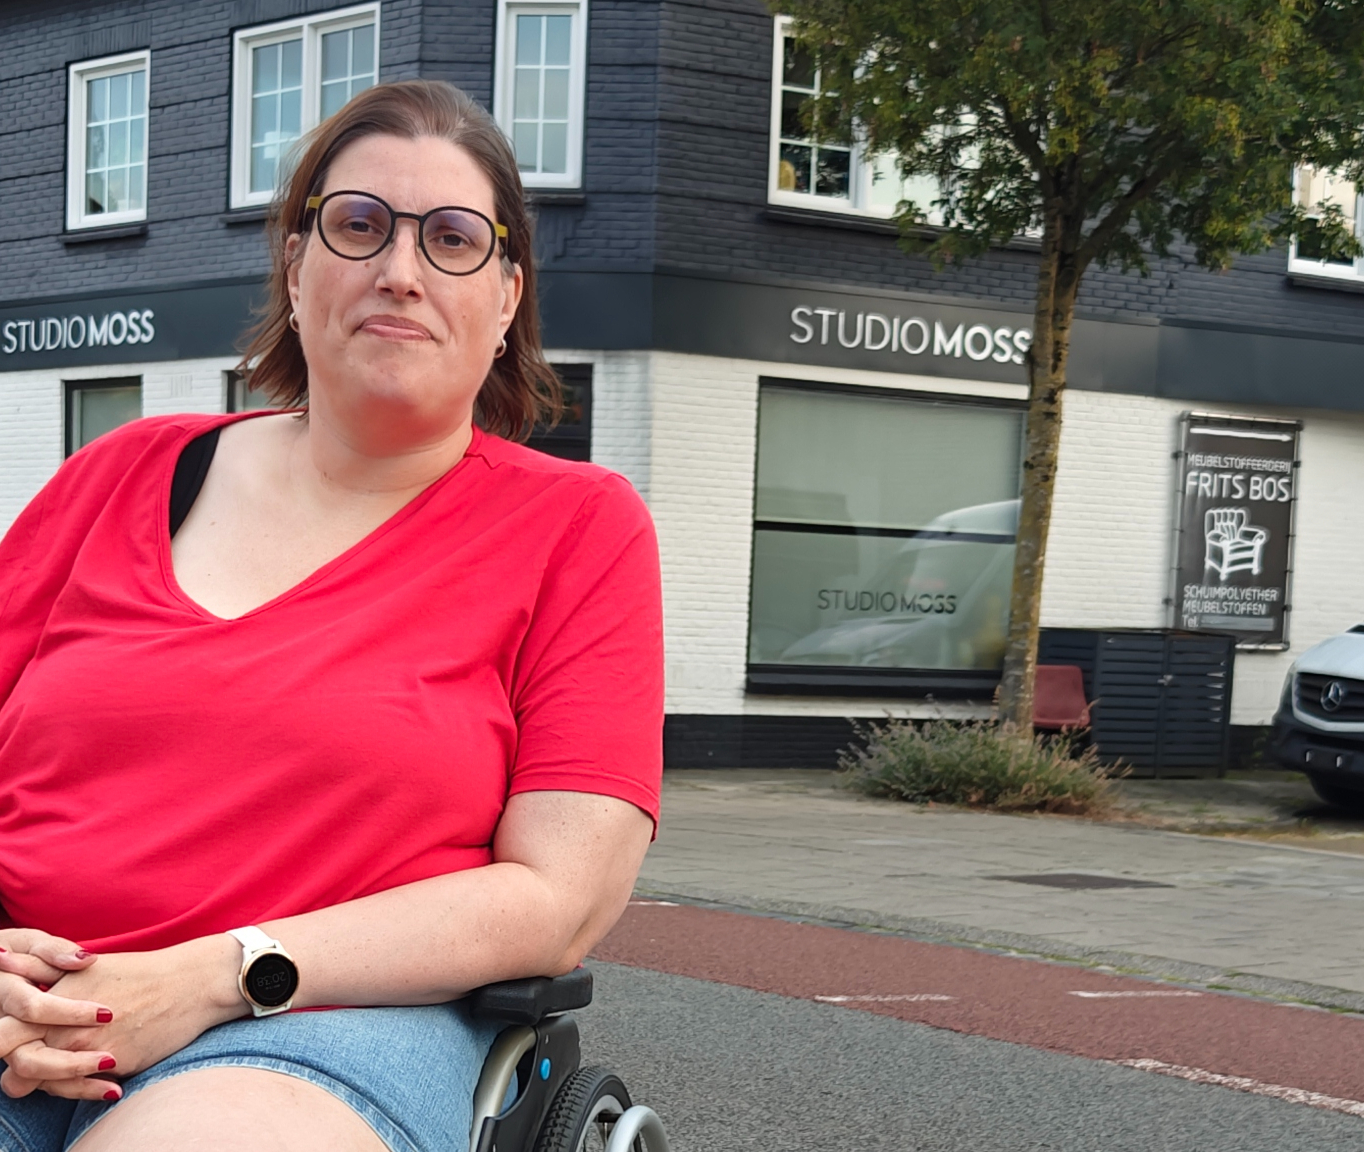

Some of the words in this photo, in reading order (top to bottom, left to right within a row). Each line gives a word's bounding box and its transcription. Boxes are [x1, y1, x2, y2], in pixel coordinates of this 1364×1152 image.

[1185, 470, 1247, 500] FRITS
[1248, 475, 1292, 502] BOS
[1183, 584, 1279, 602] SCHUIMPOLYETHER
[1182, 599, 1267, 616] MEUBELSTOFFEN
